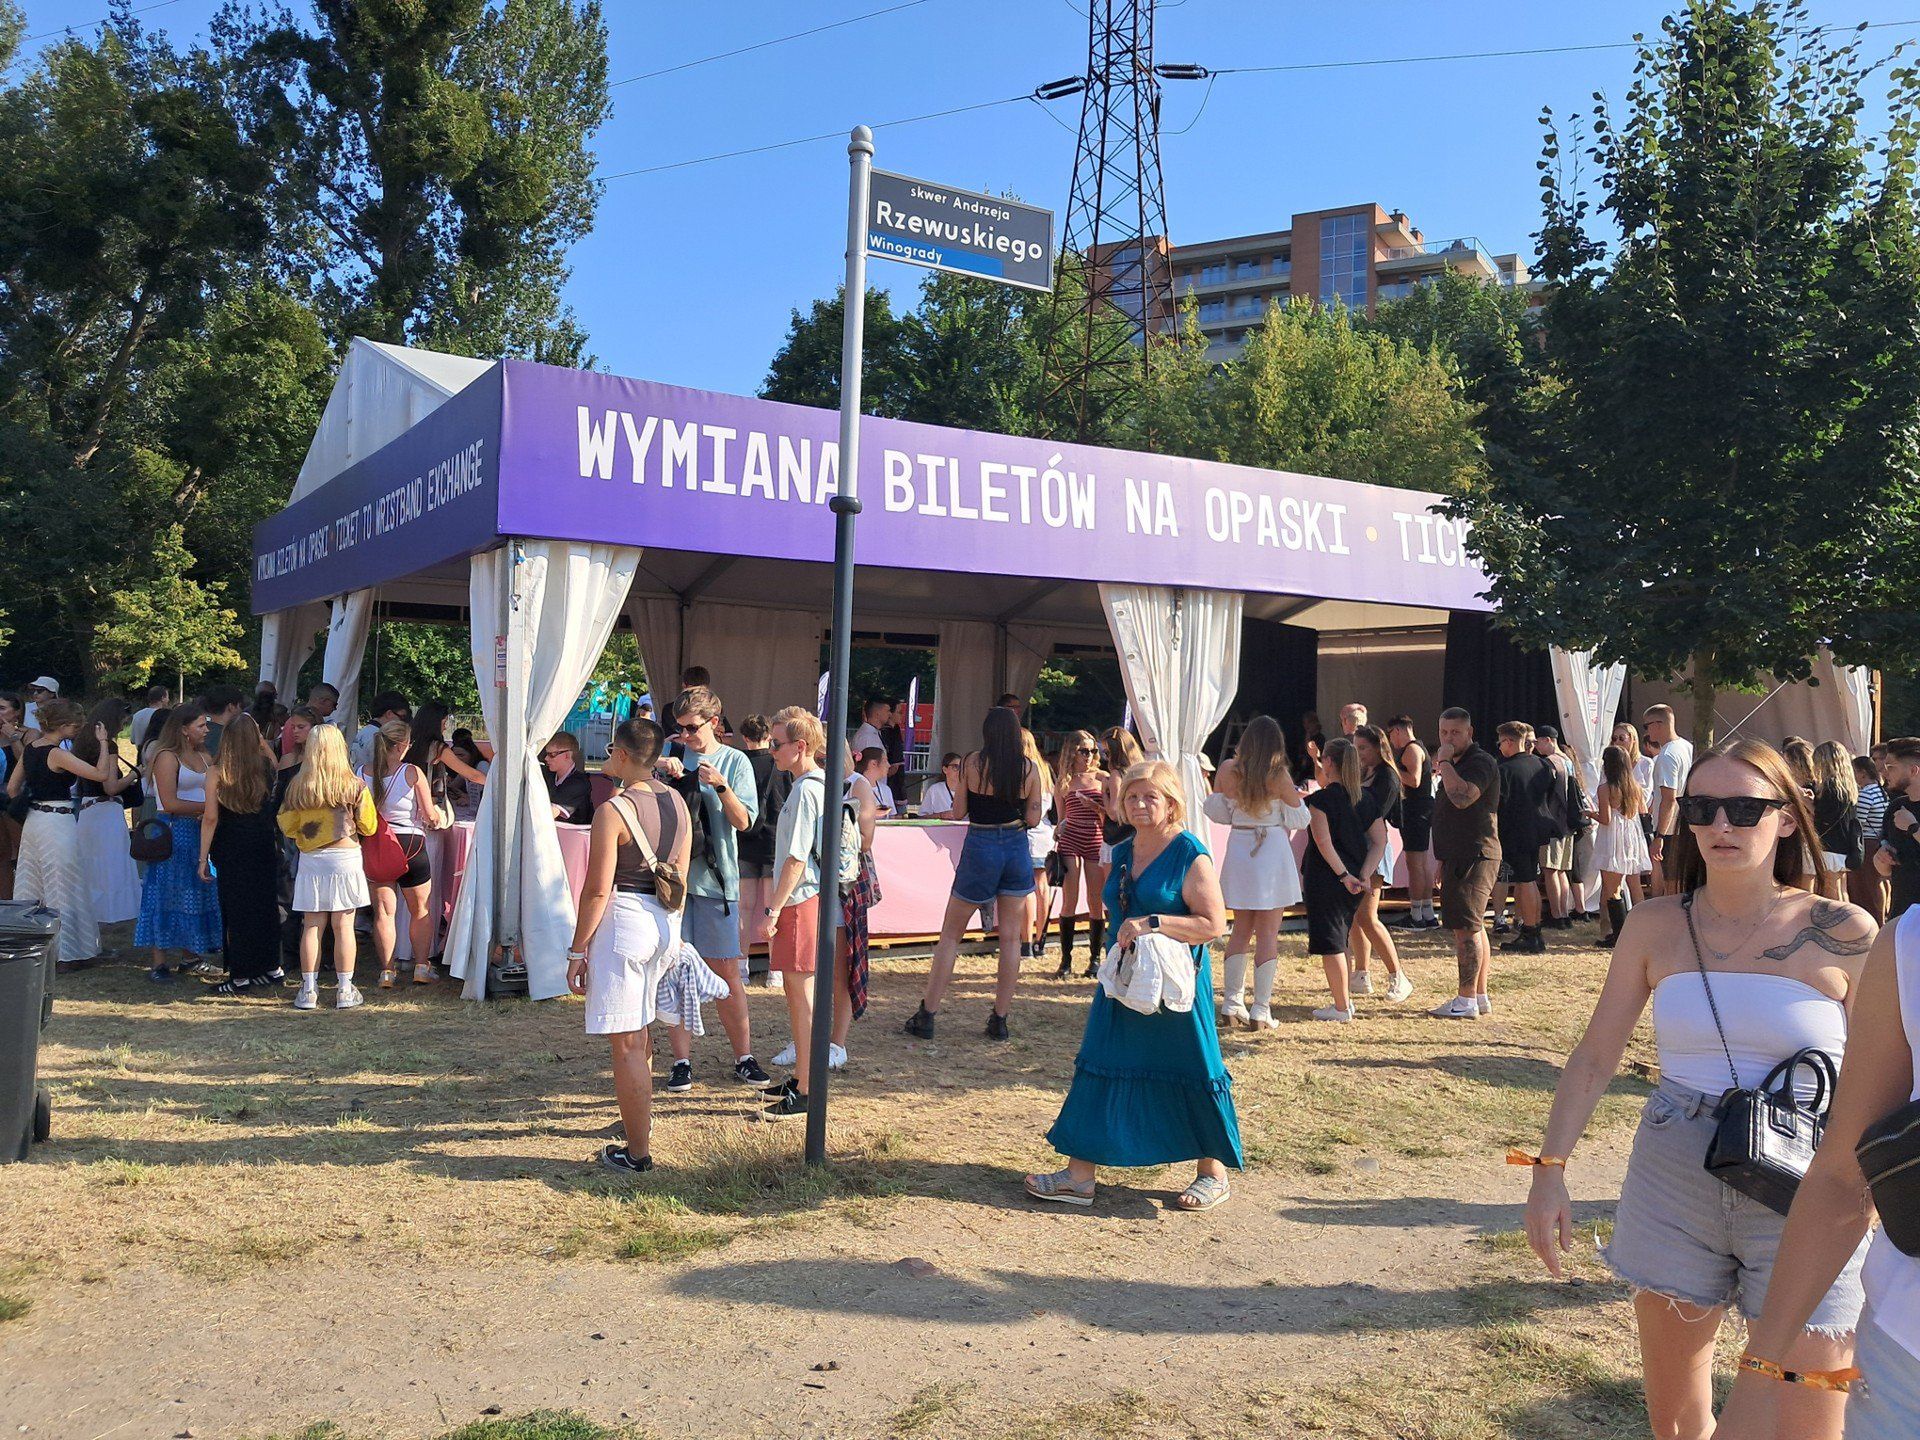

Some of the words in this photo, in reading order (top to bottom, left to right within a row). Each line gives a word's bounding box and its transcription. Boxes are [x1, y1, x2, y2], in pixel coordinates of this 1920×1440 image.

[876, 200, 1043, 263] Rzewuskiego
[910, 186, 947, 204] skwer
[952, 196, 1010, 222] Andrzeja
[869, 234, 943, 265] Winogrady
[335, 509, 360, 552] TICKET
[362, 503, 373, 541] TO
[375, 477, 423, 536] WRISTBAND
[427, 438, 484, 512] EXCHANGE
[577, 405, 839, 505] WYMIANA
[883, 449, 1096, 530] BILETÓW
[1124, 477, 1180, 538] NA
[1204, 486, 1351, 556] OPASKI
[1392, 511, 1485, 569] TICK
